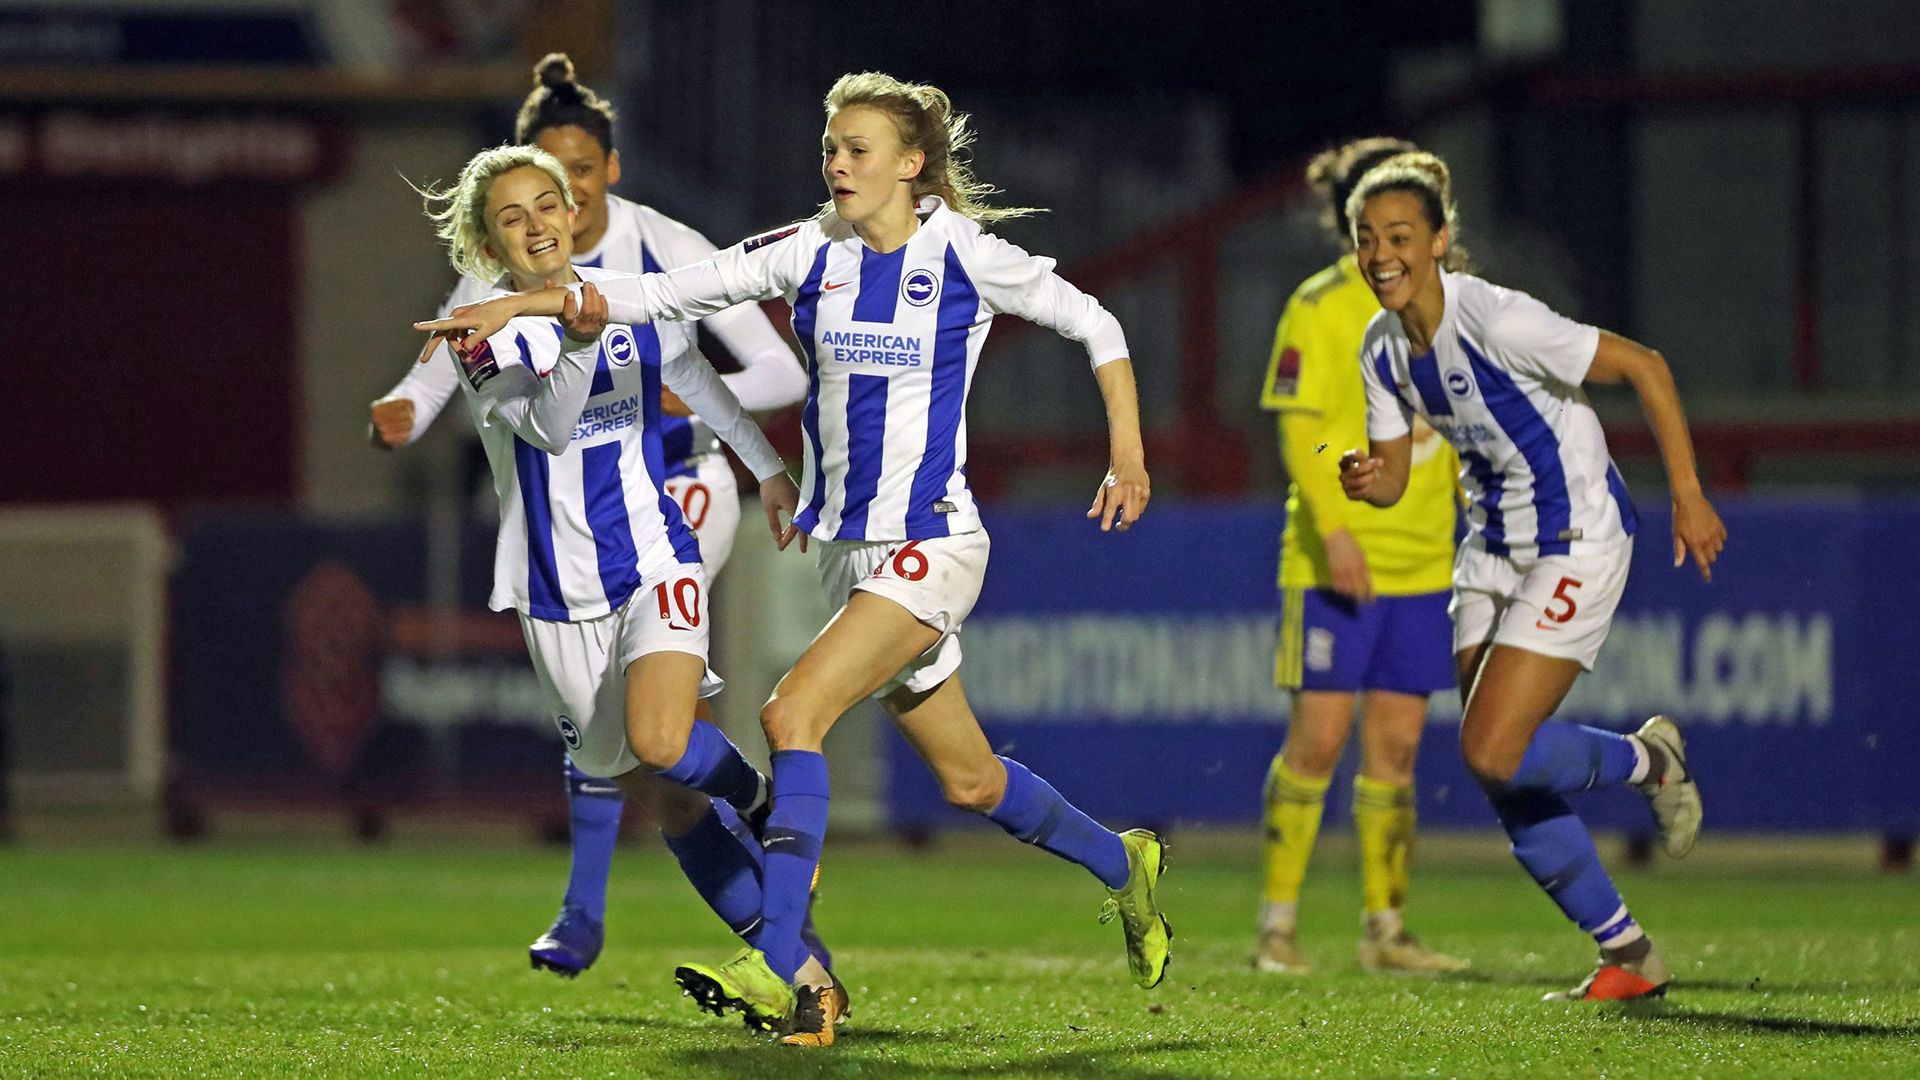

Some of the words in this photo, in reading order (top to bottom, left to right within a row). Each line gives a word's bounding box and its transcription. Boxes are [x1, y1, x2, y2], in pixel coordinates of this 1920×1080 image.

[821, 330, 921, 352] AMERICAN
[834, 348, 921, 367] EXPRESS
[577, 395, 639, 425] ERICAN
[652, 577, 700, 628] 10
[1543, 575, 1583, 624] 5
